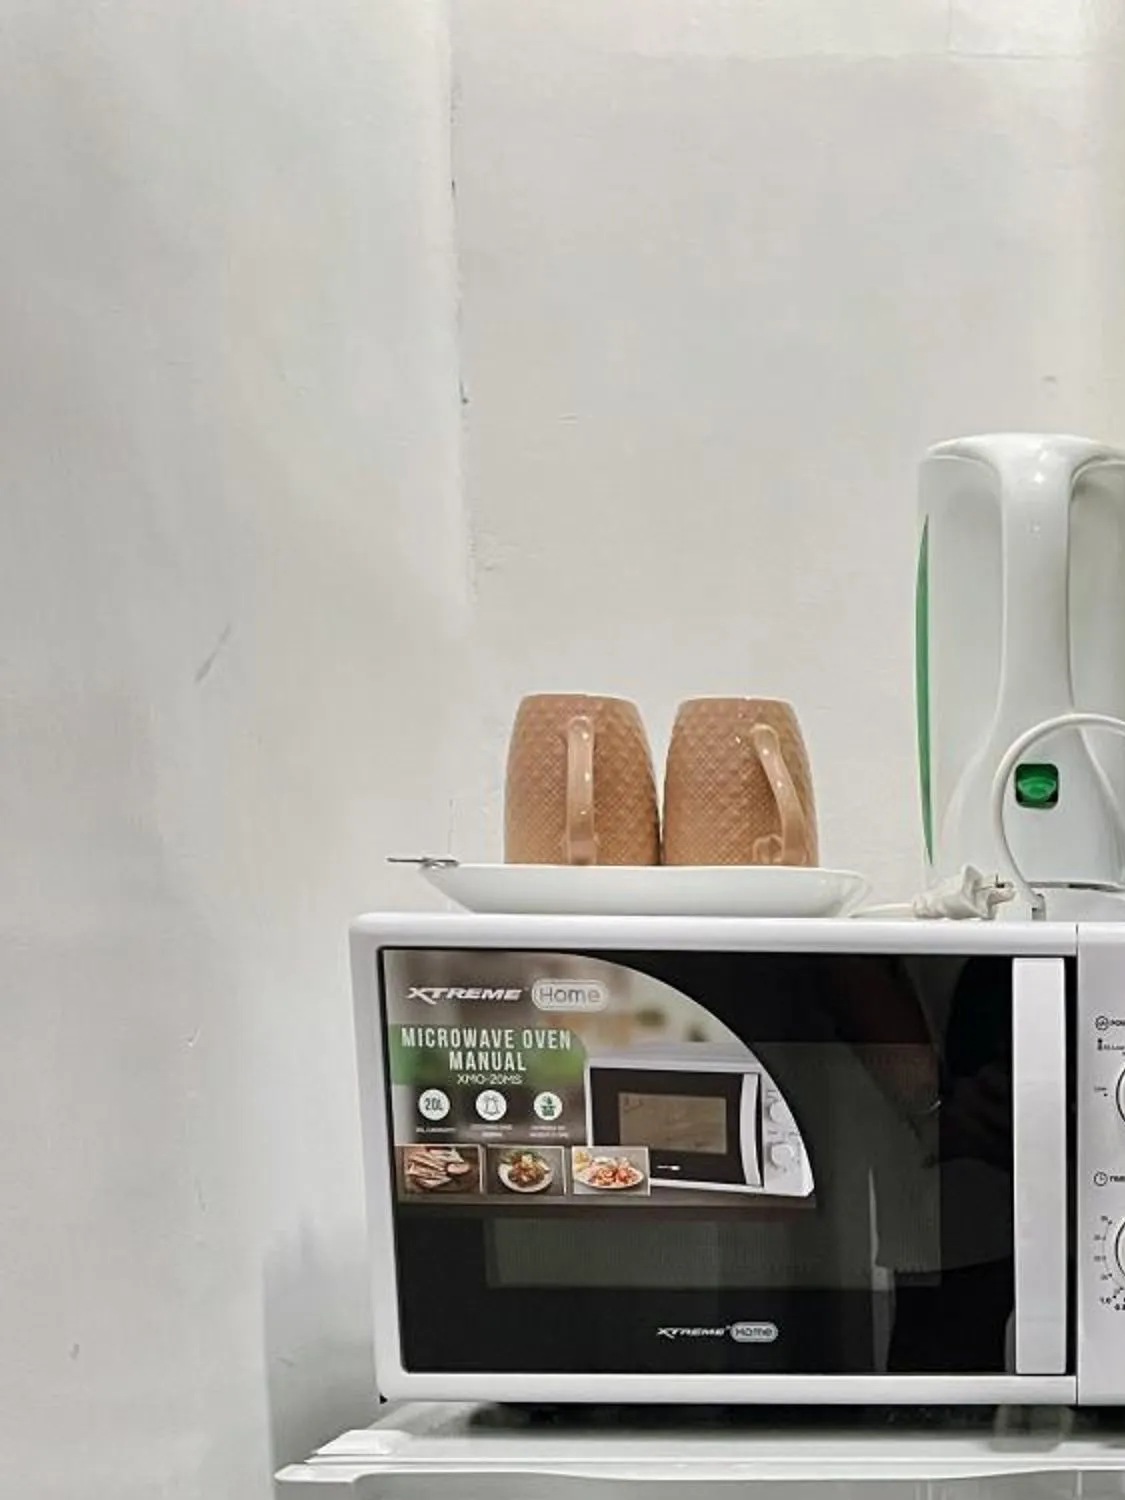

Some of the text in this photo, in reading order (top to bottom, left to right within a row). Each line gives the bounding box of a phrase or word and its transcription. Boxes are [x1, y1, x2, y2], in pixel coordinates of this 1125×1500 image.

[407, 983, 600, 1005] XTREME Home
[401, 1028, 572, 1050] MICROWAVE OVEN
[449, 1052, 527, 1071] MANUAL
[457, 1074, 523, 1085] XMO-20MS
[424, 1097, 444, 1111] 20L
[656, 1327, 725, 1339] XTREME
